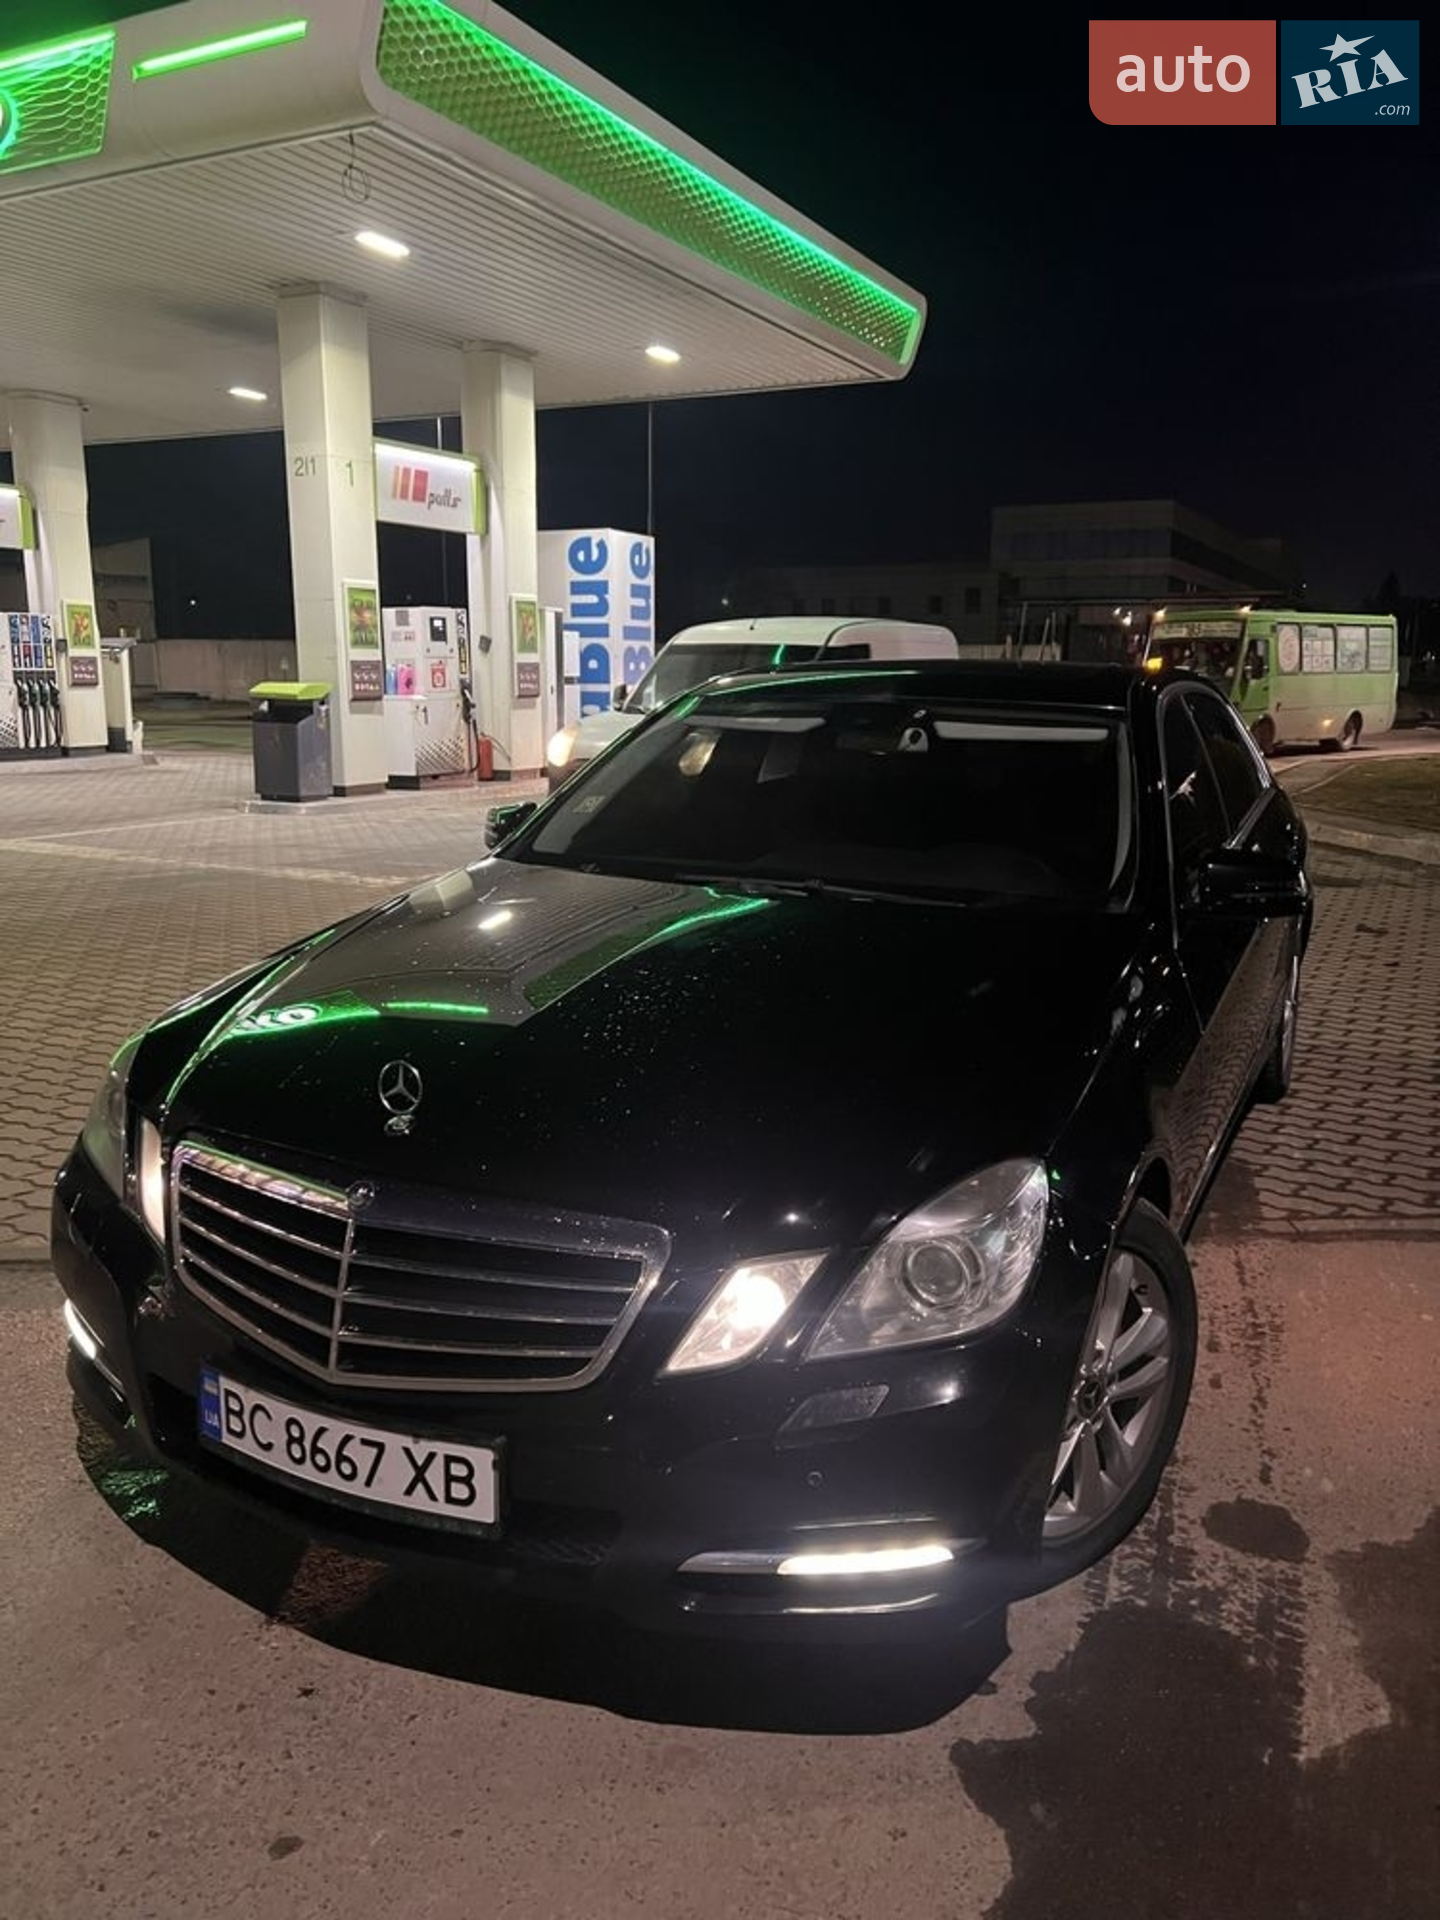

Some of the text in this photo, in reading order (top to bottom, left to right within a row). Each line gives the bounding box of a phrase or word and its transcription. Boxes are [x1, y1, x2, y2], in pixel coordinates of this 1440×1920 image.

[224, 1387, 477, 1507] BC 8667 XB
